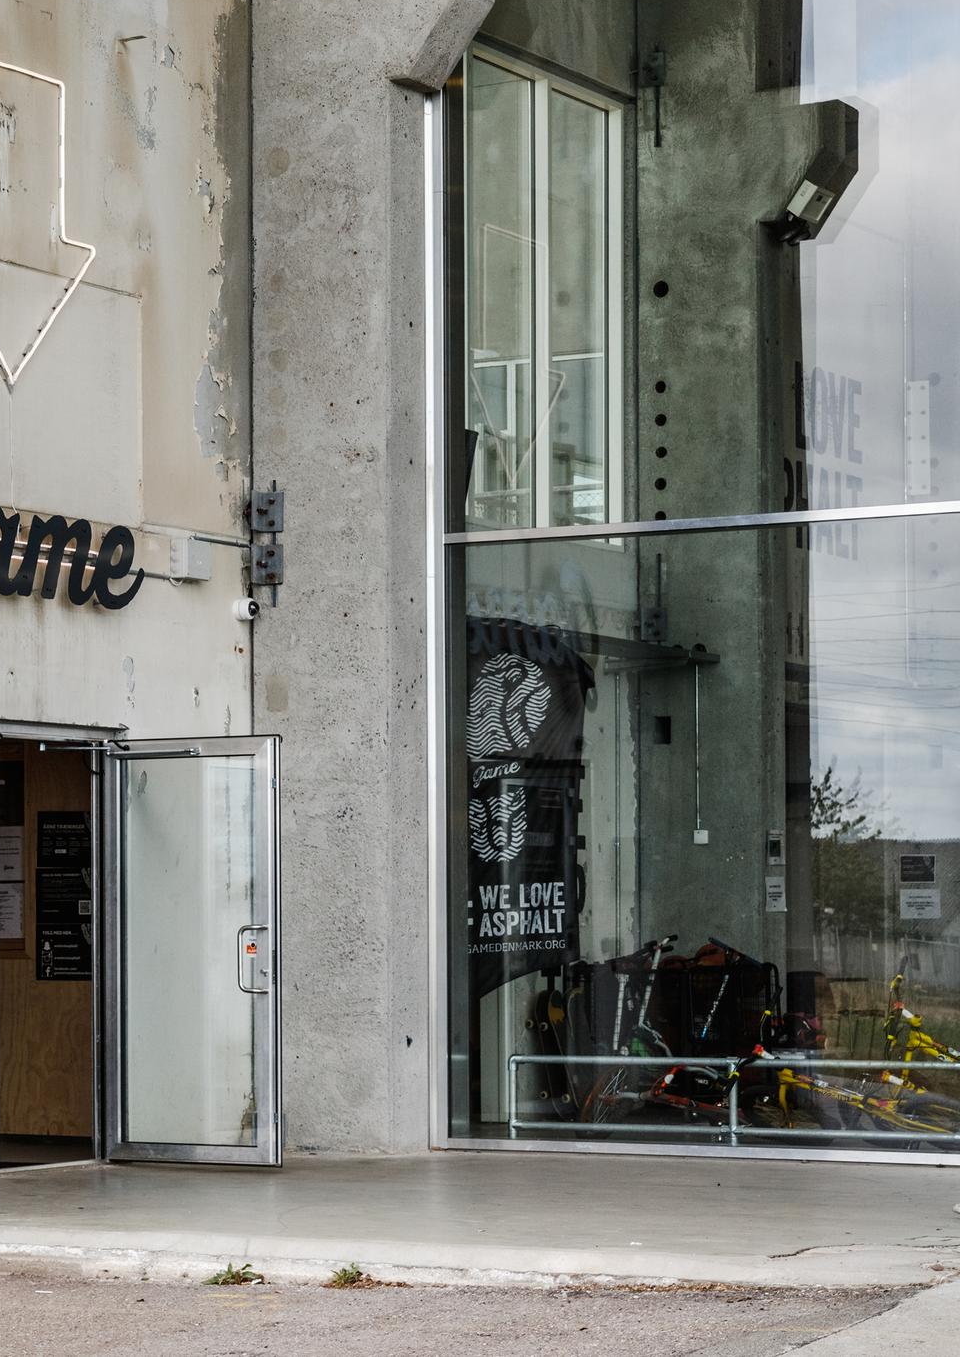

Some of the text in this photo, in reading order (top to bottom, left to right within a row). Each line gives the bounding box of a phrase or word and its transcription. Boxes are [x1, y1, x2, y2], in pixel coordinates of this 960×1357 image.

[794, 361, 863, 464] LOVE
[473, 761, 521, 789] Game
[478, 882, 565, 910] WE LOVE
[479, 909, 565, 937] ASPHALT
